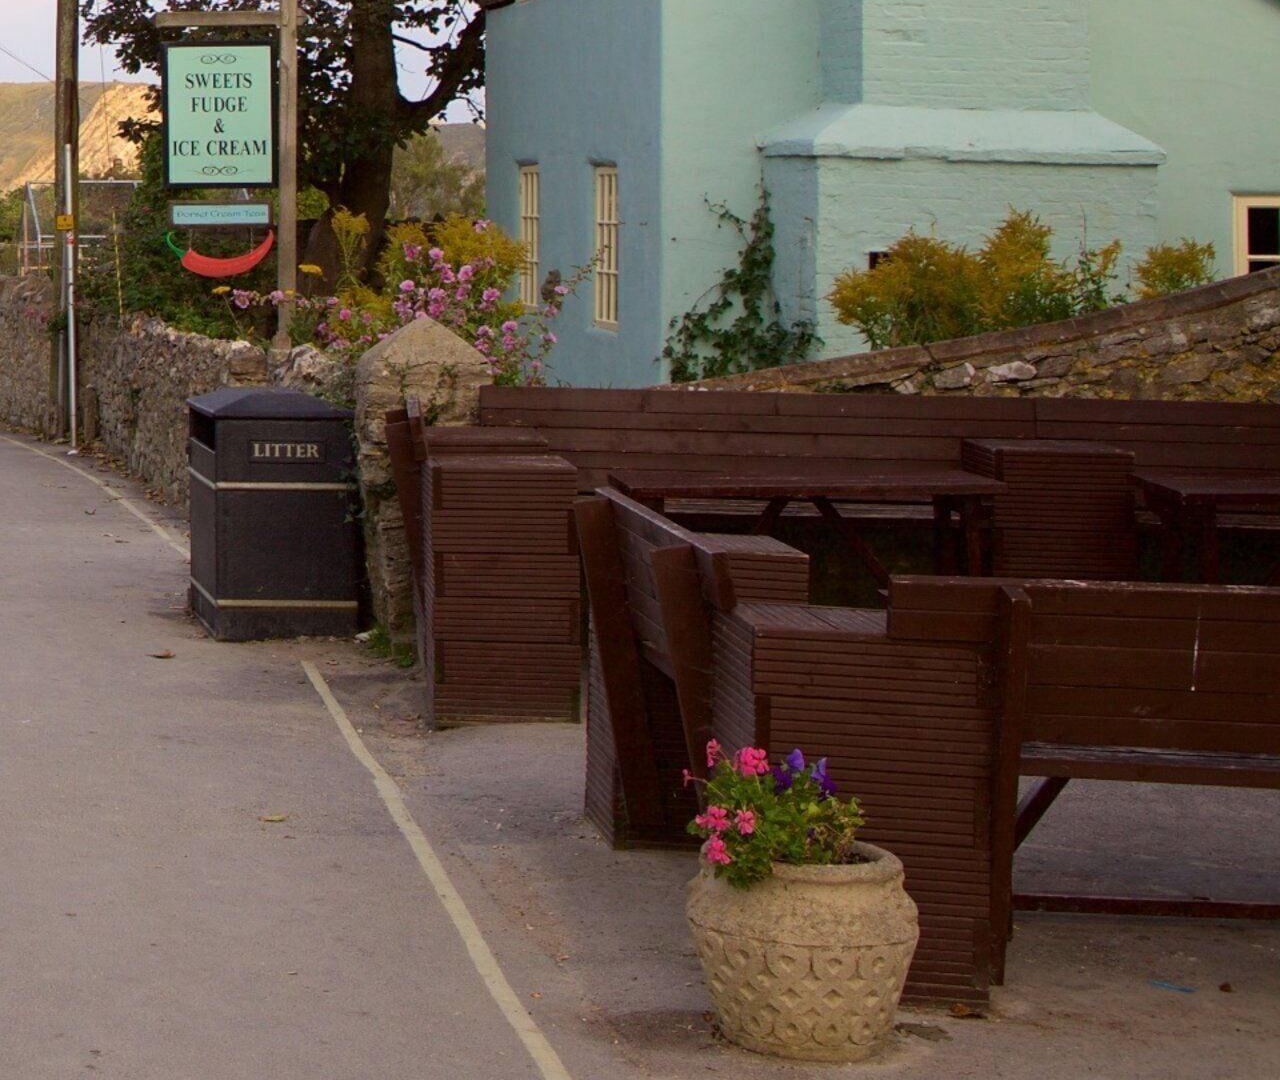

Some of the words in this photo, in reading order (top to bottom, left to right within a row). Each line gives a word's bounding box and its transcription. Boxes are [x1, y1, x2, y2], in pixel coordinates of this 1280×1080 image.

[184, 73, 253, 89] SWEETS
[191, 96, 248, 112] FUDGE
[213, 118, 225, 133] &
[173, 140, 200, 156] ICE
[206, 139, 267, 156] CREAM
[253, 443, 320, 458] LITTER
